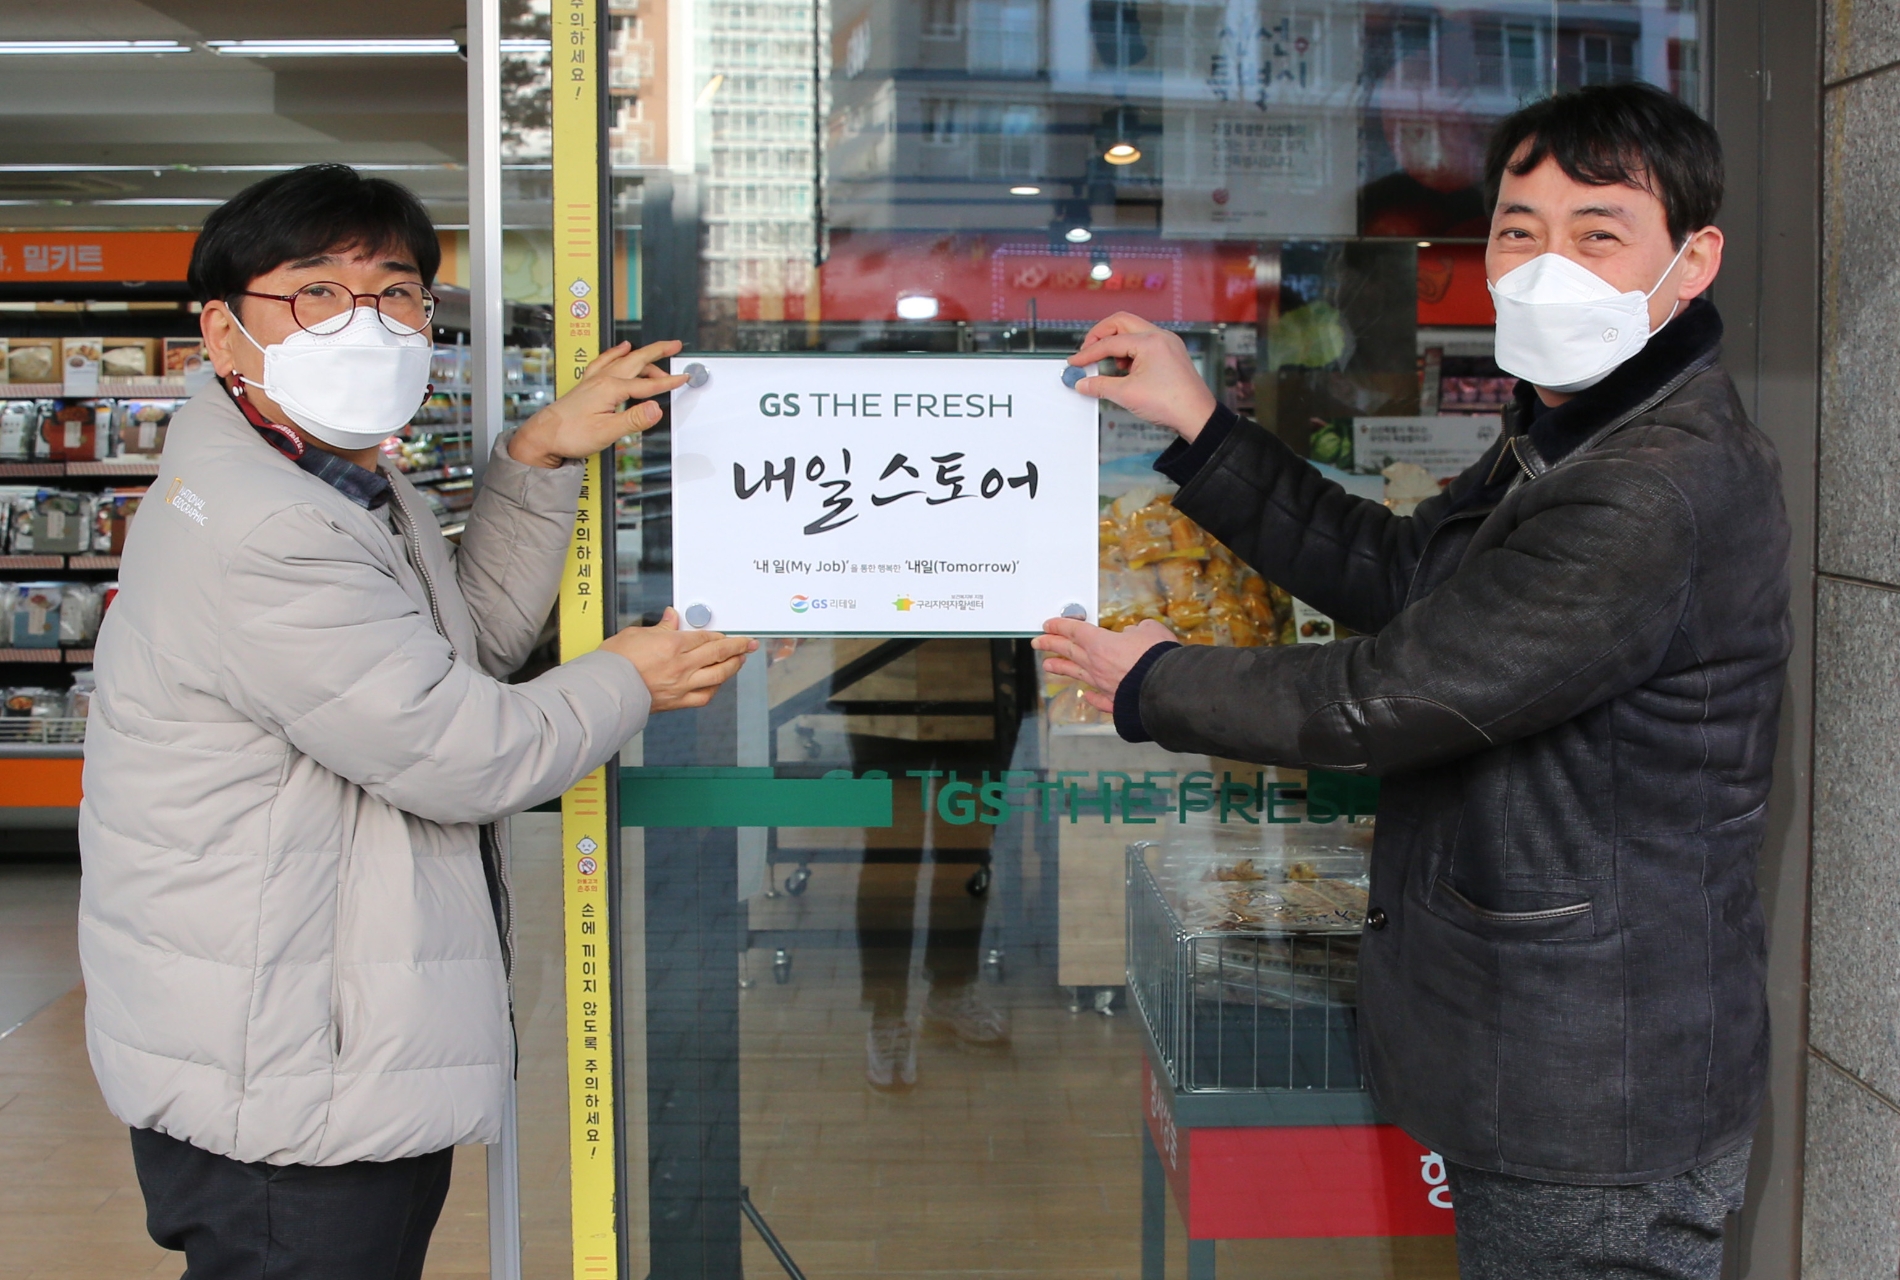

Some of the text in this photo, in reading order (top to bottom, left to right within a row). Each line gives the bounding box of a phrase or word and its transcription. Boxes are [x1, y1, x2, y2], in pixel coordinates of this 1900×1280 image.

[23, 245, 104, 272] 밀키트
[759, 393, 1013, 418] GS THE FRESH
[172, 495, 208, 527] GEOGRAPHIC
[860, 564, 876, 573] 통한
[877, 564, 901, 573] 행복한
[811, 599, 857, 609] GS 리테일
[916, 600, 984, 611] 구리지역자활센터
[937, 781, 1012, 825] GS
[1027, 782, 1156, 824] THE
[581, 903, 600, 1160] 손에 끼이지 않도록 주의하세요!
